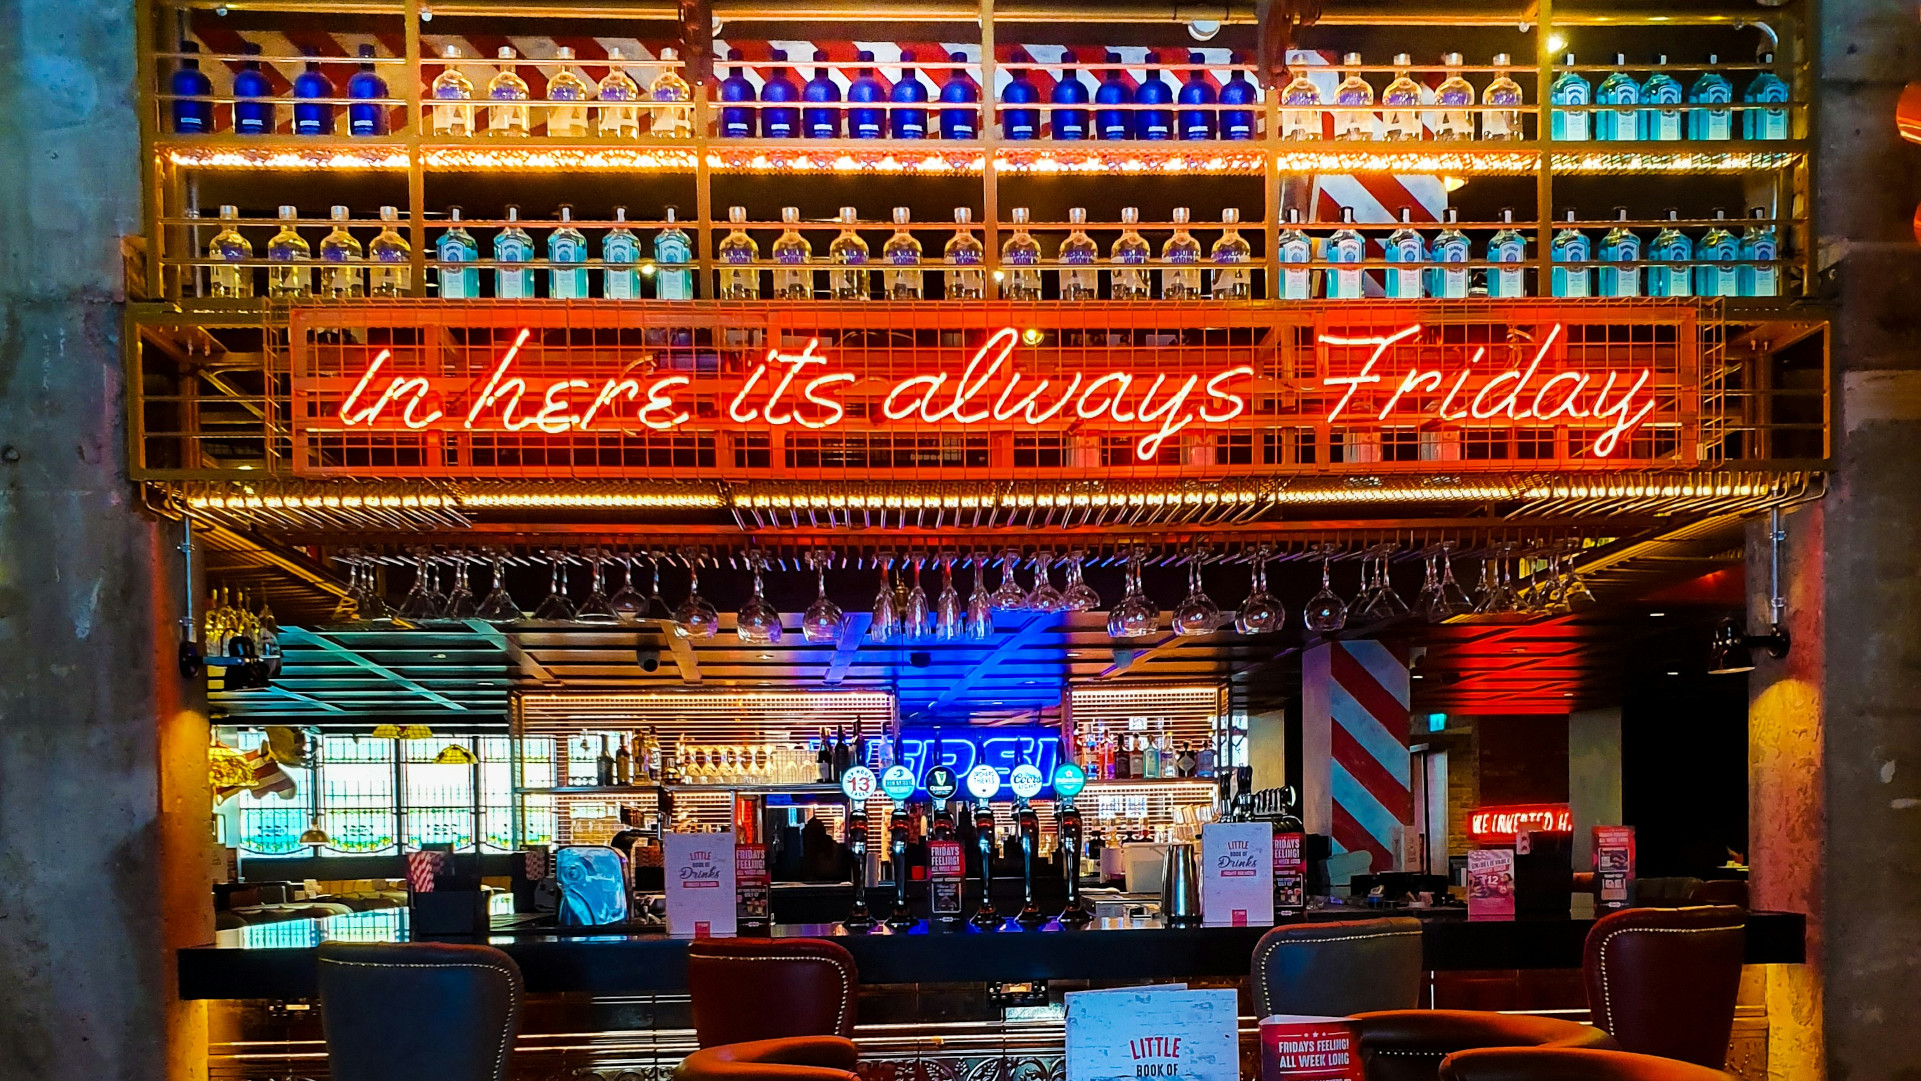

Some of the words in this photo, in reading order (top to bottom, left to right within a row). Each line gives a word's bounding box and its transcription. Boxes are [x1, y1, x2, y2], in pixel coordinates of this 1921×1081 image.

[338, 350, 443, 429] In
[465, 328, 690, 434] here
[730, 338, 856, 428] its
[883, 327, 1255, 462] always
[1318, 322, 1657, 460] Friday
[1013, 772, 1042, 784] Coors
[850, 777, 870, 792] 13
[1228, 840, 1249, 850] LITTLE
[1273, 839, 1300, 849] RIDAYS
[690, 851, 711, 860] LITTLE
[736, 849, 765, 859] FRIDAYS
[931, 846, 960, 857] FRIDAYS
[1274, 849, 1300, 859] EELING!
[931, 856, 960, 866] FEELING!
[1217, 855, 1257, 869] Drinks
[680, 866, 720, 879] Drinks
[1129, 1036, 1182, 1060] LITTLE
[1278, 1040, 1315, 1053] FRIDAYS
[1316, 1039, 1350, 1052] FEELING!
[1279, 1055, 1297, 1068] ALL
[1298, 1054, 1326, 1068] WEEK
[1328, 1052, 1350, 1066] LONG
[1136, 1063, 1164, 1078] BOOK
[1166, 1063, 1179, 1077] OF
